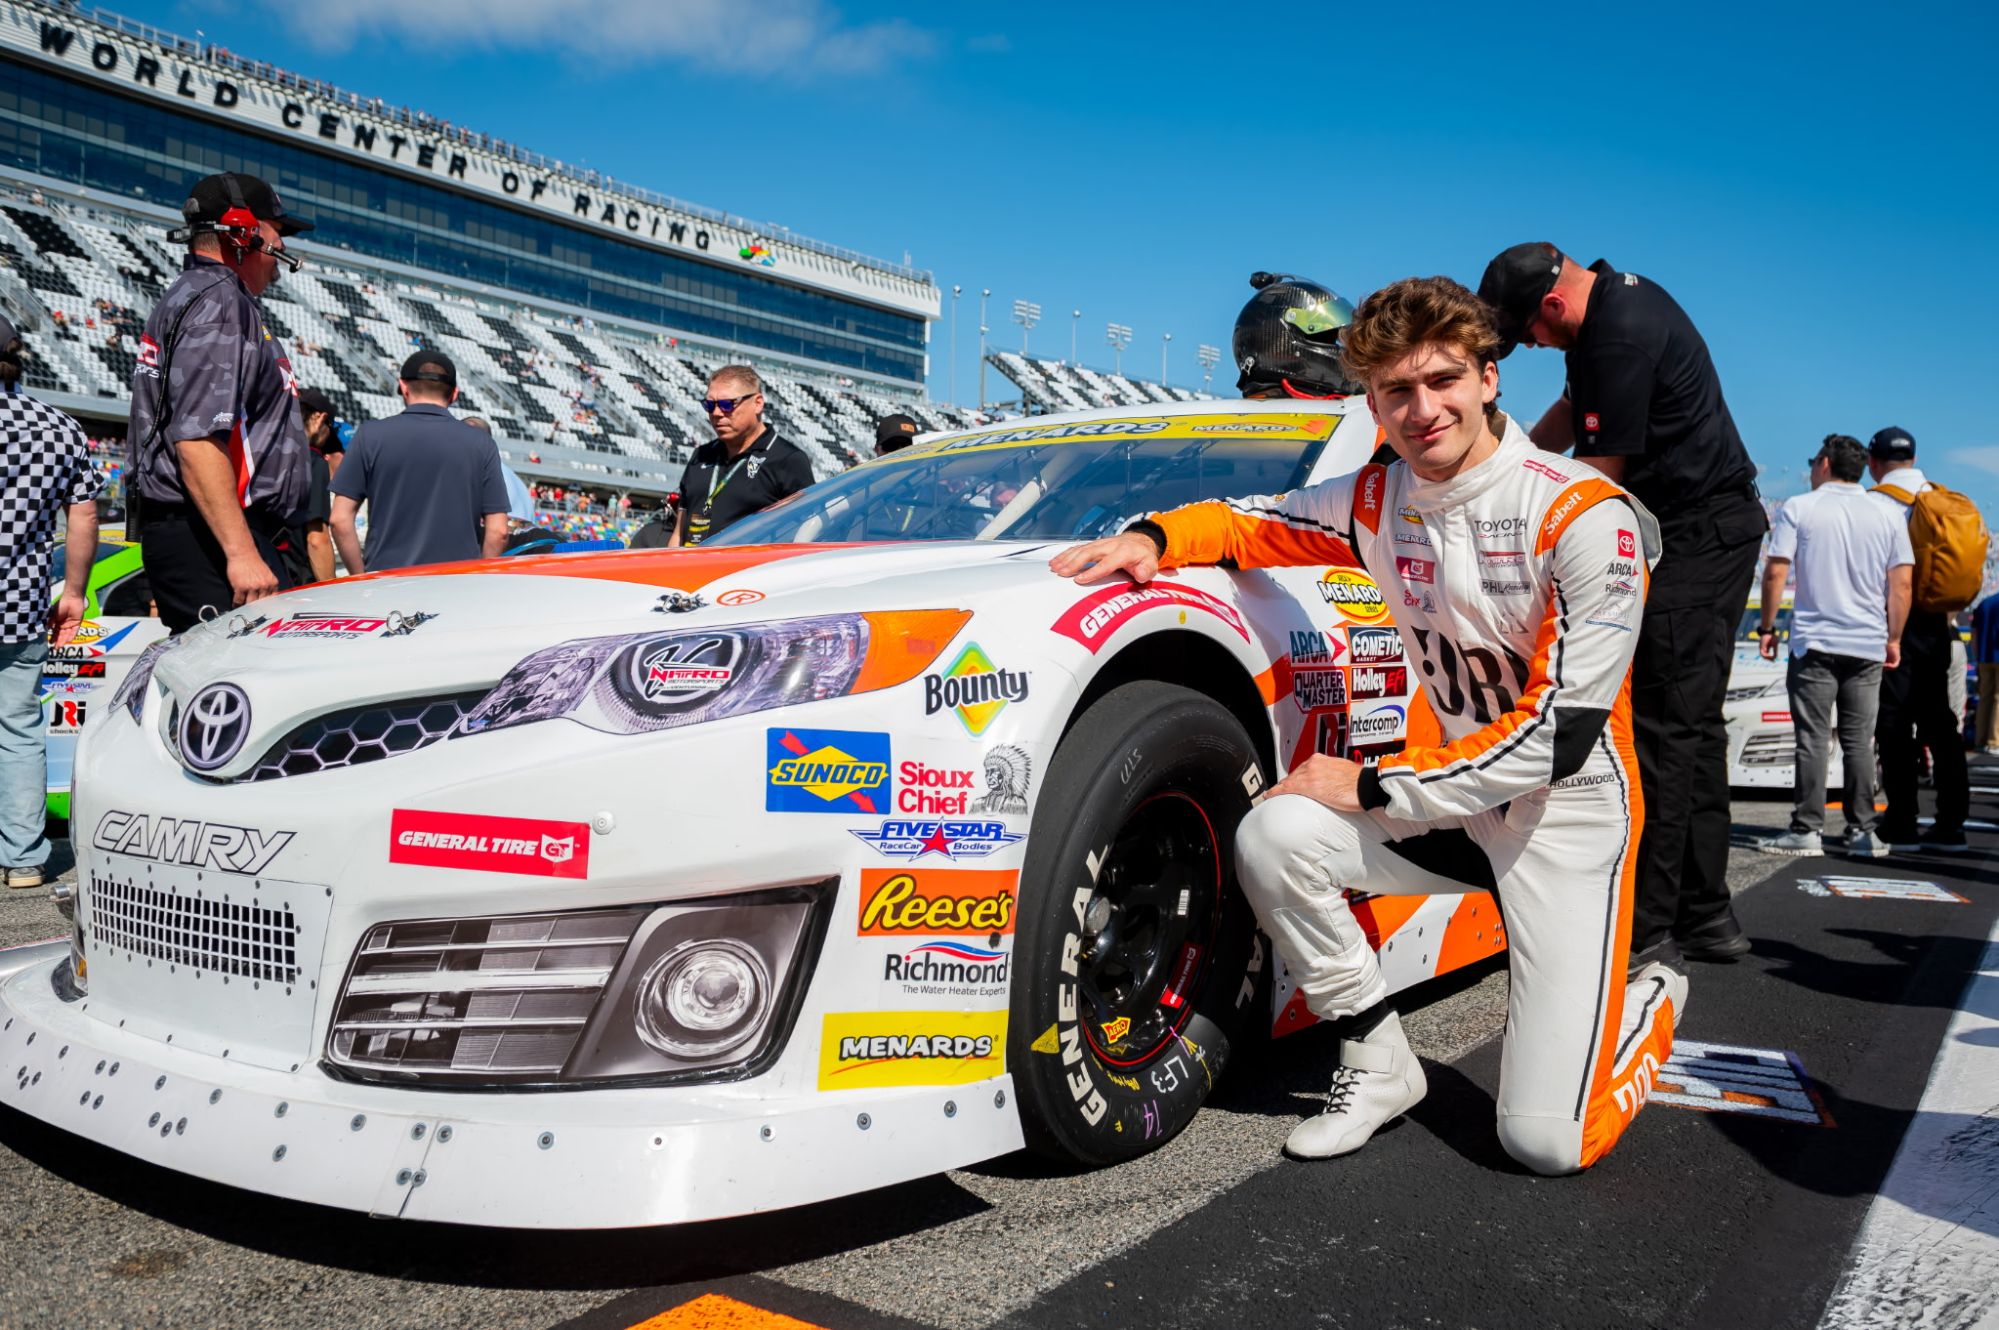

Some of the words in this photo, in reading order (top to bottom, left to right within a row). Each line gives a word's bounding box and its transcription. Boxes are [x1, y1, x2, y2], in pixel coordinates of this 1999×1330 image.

[40, 21, 239, 108] WORLD
[281, 103, 467, 179] CENTER
[502, 172, 547, 200] OF
[574, 192, 710, 250] RACING
[937, 422, 1170, 452] MENARDS
[1364, 472, 1380, 510] Sabelt
[1475, 518, 1527, 532] TOYOTA
[1545, 491, 1584, 535] Sabelt
[1607, 563, 1632, 576] ARCA
[1317, 580, 1384, 604] MENARD
[1080, 588, 1169, 638] GENERAL
[256, 618, 388, 638] NITRO
[1290, 631, 1328, 664] ARCA
[1351, 634, 1403, 657] COMETIC
[650, 665, 731, 684] NITRO
[1294, 672, 1344, 698] QUARTER
[1353, 667, 1385, 696] Holley
[924, 667, 1029, 716] Bounty
[1302, 687, 1346, 708] MASTER
[1350, 715, 1399, 734] Intercomp
[775, 762, 882, 785] SUNOCO
[898, 760, 975, 789] Sioux
[1549, 774, 1615, 788] HOLLYWOOD
[898, 788, 968, 816] Chief
[92, 809, 298, 876] CAMRY
[398, 830, 489, 853] GENERAL
[491, 836, 539, 857] TIRE
[881, 822, 935, 839] FIVE
[944, 822, 1004, 840] STAR
[880, 841, 922, 850] RaceCar
[953, 842, 993, 851] Bodies
[861, 875, 1013, 929] Reese's
[884, 951, 1009, 983] Richmond
[903, 984, 919, 994] The
[920, 985, 947, 995] Water
[948, 986, 978, 996] Heater
[979, 986, 1006, 997] Experts
[1109, 1021, 1127, 1037] AERO
[840, 1035, 993, 1060] MENARDS
